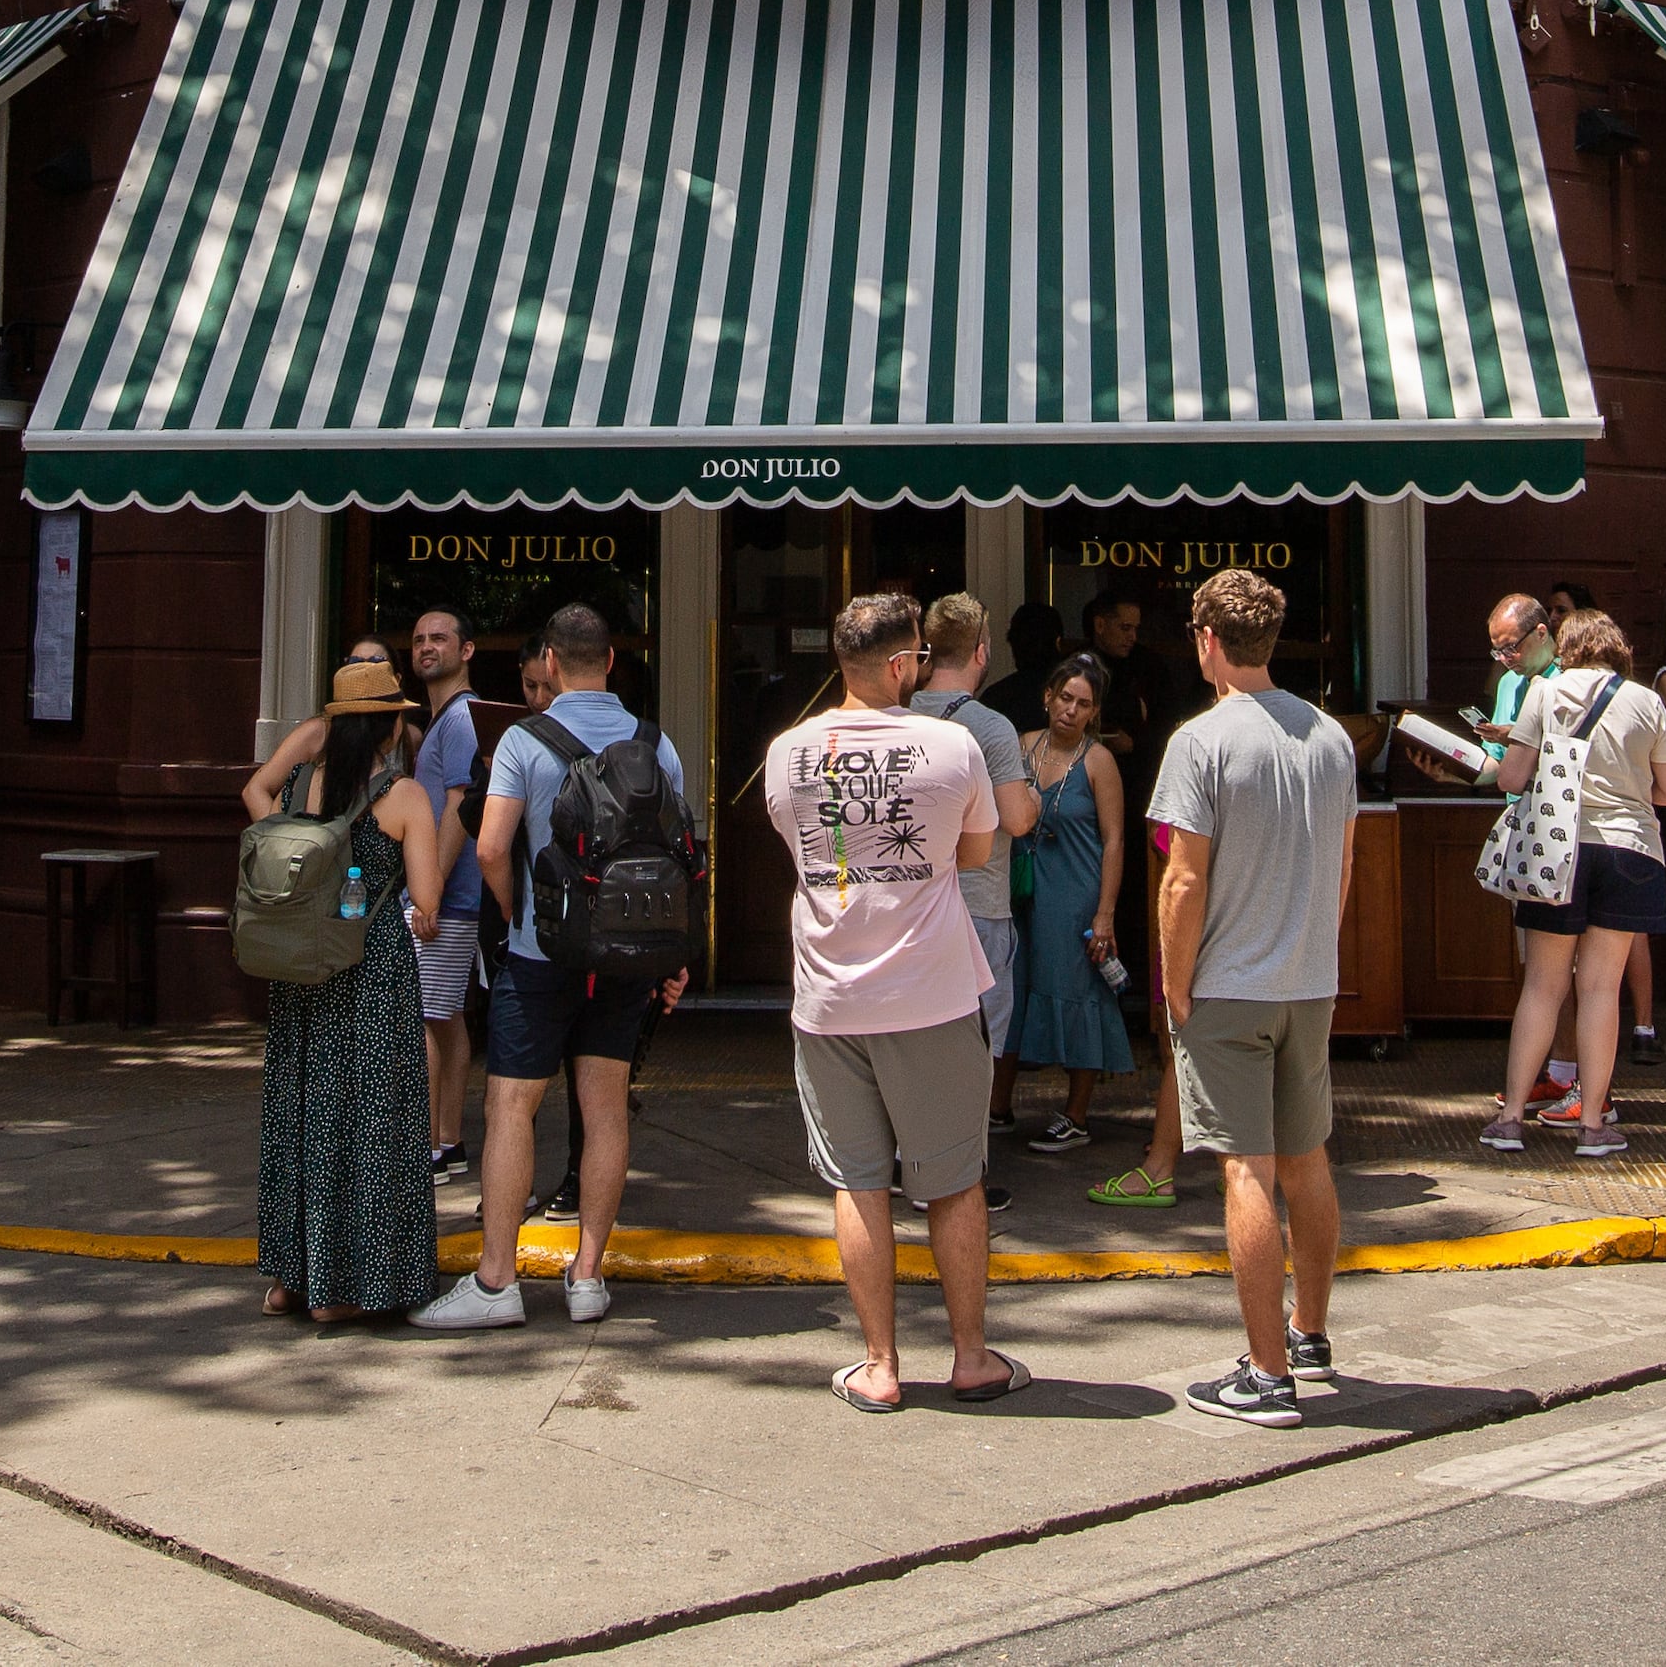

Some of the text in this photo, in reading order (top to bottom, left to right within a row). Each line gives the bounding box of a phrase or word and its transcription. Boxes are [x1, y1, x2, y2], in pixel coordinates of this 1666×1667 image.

[700, 458, 841, 483] DON JULIO
[408, 535, 617, 569] DON JULIO
[1079, 541, 1293, 574] DON JULIO
[814, 748, 911, 776] MOVE
[822, 774, 903, 800] YOUR
[819, 797, 914, 827] SOLE
